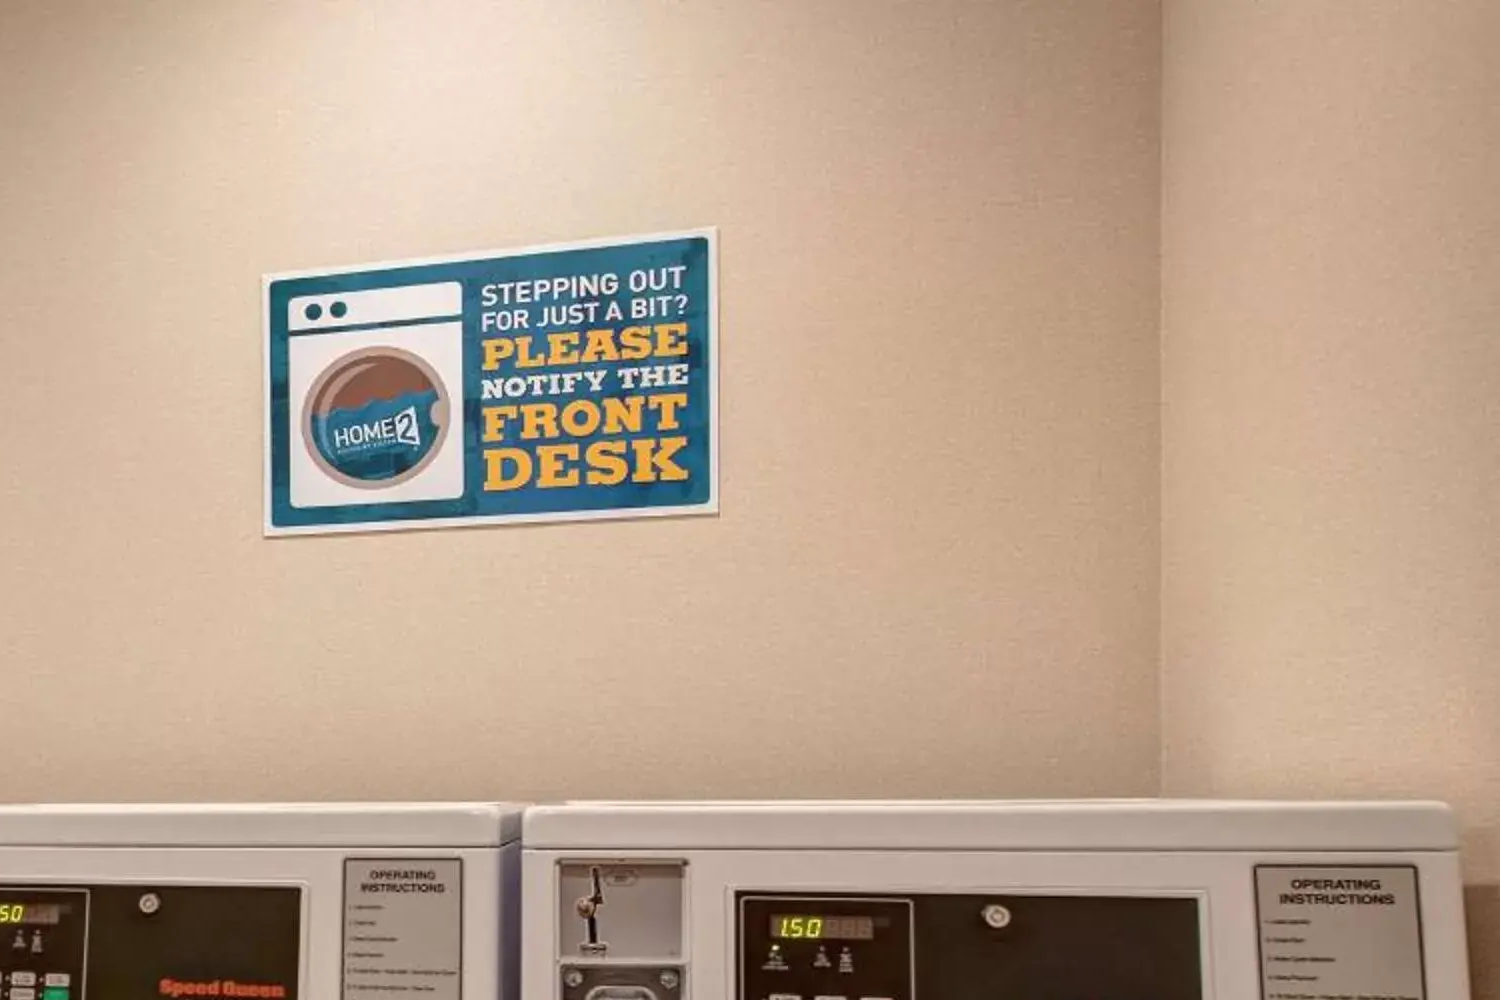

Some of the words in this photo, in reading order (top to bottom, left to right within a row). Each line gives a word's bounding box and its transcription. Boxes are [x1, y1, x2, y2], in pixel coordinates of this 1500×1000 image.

[481, 272, 619, 307] STEPPING
[629, 266, 687, 292] OUT
[481, 312, 529, 333] FOR
[537, 302, 599, 328] JUST
[604, 301, 622, 321] A
[631, 295, 688, 319] BIT?
[481, 322, 688, 371] PLEASE
[481, 369, 606, 399] NOTIFY
[617, 365, 688, 388] THE
[482, 393, 688, 442] FRONT
[483, 437, 689, 492] DESK
[360, 883, 445, 893] INSTRUCTIONS
[369, 869, 436, 882] OPERATING
[1291, 879, 1381, 890] OPERATING
[1279, 893, 1396, 905] INSTRUCTIONS
[160, 979, 219, 998] Speed
[222, 980, 286, 998] Queen
